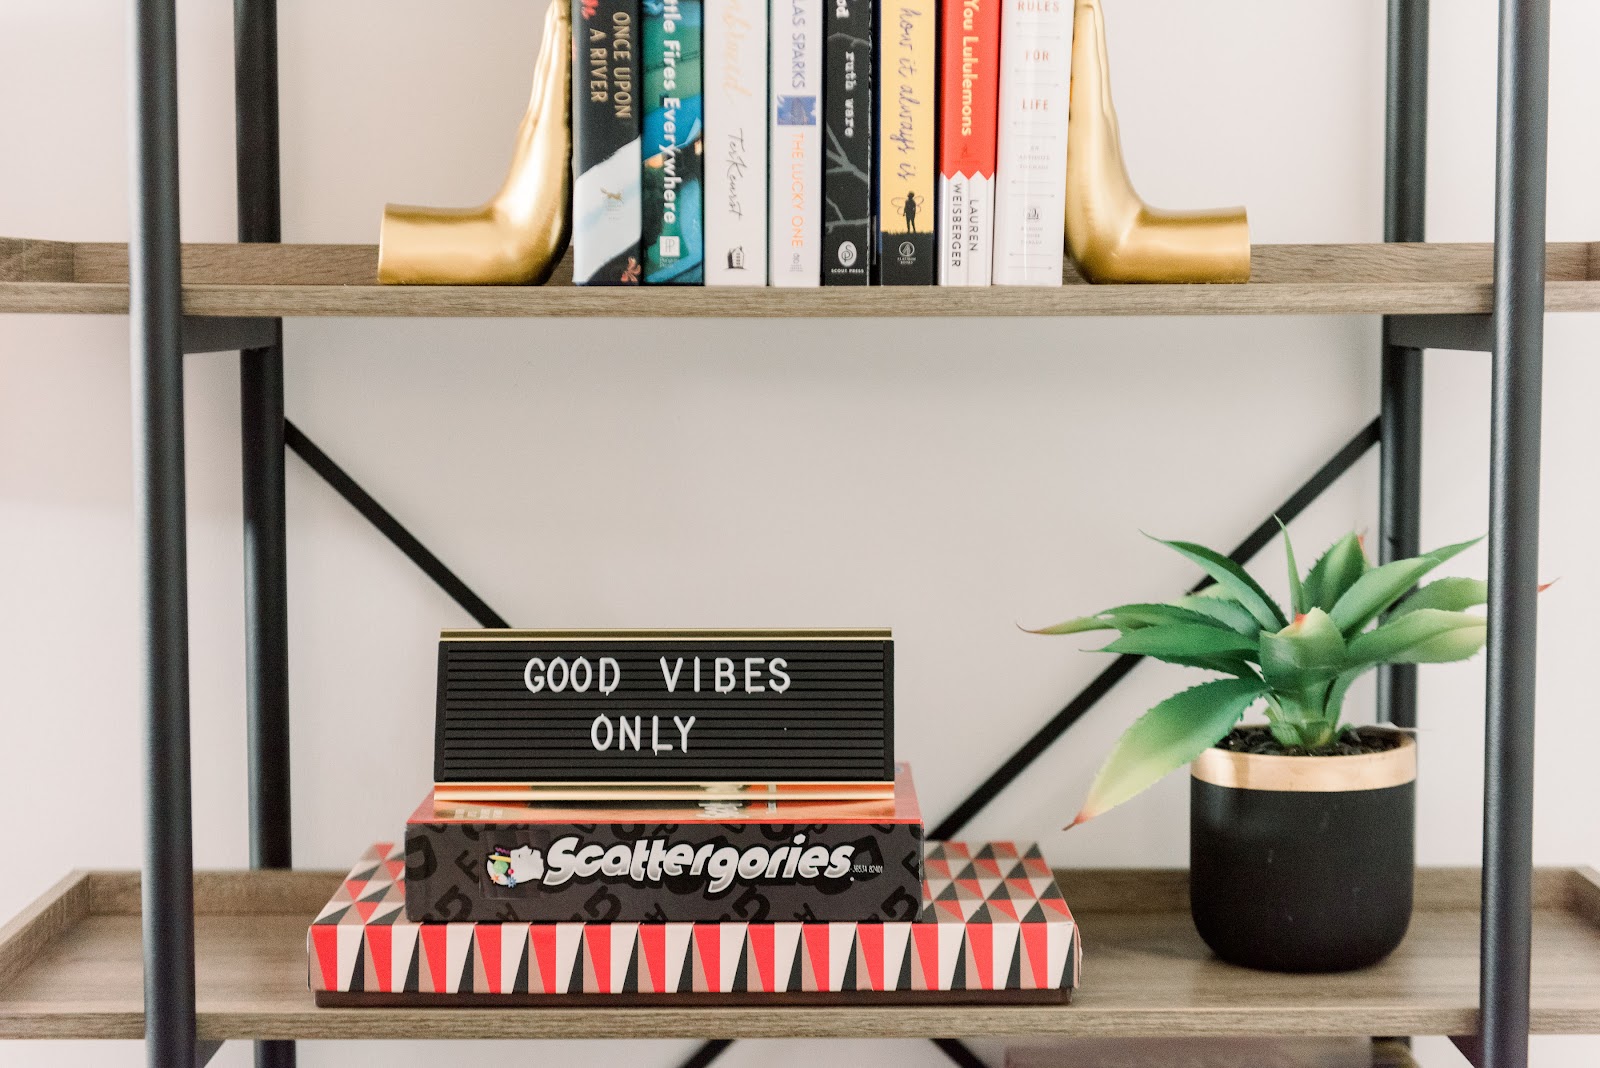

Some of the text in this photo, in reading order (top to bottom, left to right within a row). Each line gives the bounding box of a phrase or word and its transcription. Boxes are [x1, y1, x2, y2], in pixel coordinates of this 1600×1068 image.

[1017, 0, 1060, 13] RULES
[589, 27, 609, 103] A RIVER
[612, 11, 632, 119] ONCE UPON
[663, 40, 681, 91] Fires
[791, 32, 806, 89] SPARKS
[961, 0, 980, 137] You Lululemons
[889, 7, 922, 181] how it always is
[1022, 98, 1049, 111] LIFE
[658, 97, 682, 224] Everywhere
[791, 133, 804, 159] THE
[791, 163, 804, 211] LUCKY
[791, 215, 804, 247] ONE
[951, 183, 962, 268] WEISBERGER
[969, 199, 979, 252] LAUREN
[523, 656, 791, 696] GOOD VIBES
[590, 713, 696, 756] ONLY
[543, 833, 855, 894] Scattergories
